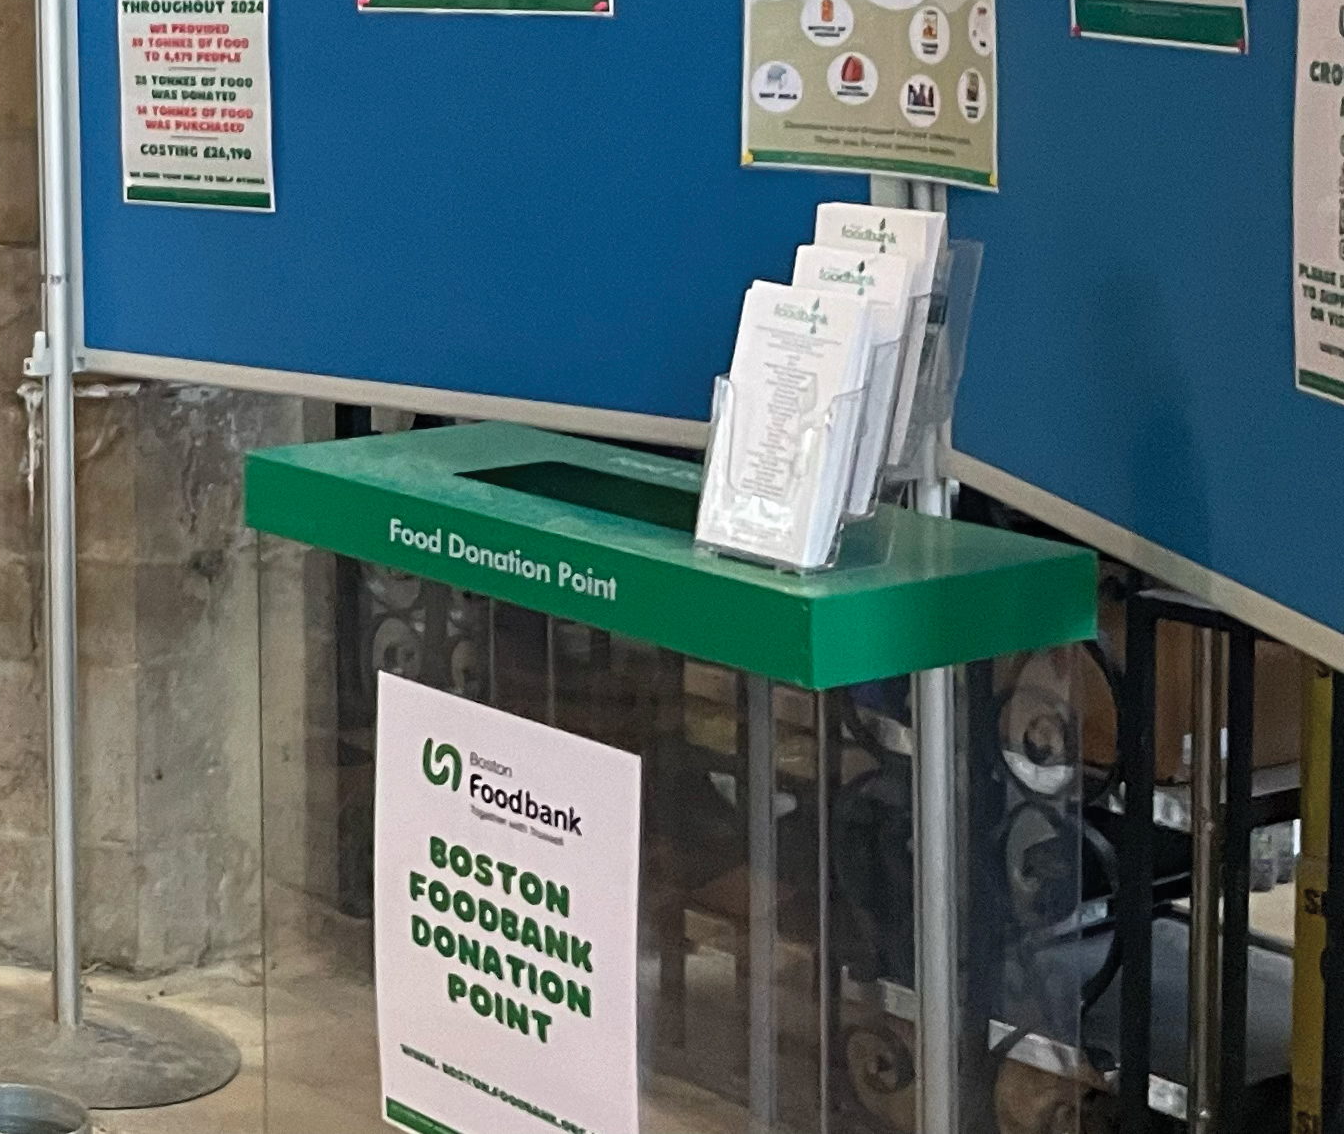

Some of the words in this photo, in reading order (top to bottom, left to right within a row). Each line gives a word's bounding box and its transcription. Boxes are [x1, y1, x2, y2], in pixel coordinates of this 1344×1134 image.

[122, 0, 225, 13] THROUGHOUT
[231, 0, 264, 13] 2024
[150, 24, 167, 33] WE
[172, 24, 229, 34] PROVIDED
[149, 38, 193, 48] TONNES
[198, 38, 213, 48] OF
[217, 38, 249, 48] FOOD
[145, 52, 159, 61] TO
[197, 52, 241, 63] PEOPLE
[152, 76, 196, 86] TONNES
[201, 77, 215, 86] OF
[221, 78, 253, 88] FOOD
[152, 90, 177, 99] WAS
[182, 90, 236, 102] DONATED
[152, 106, 197, 116] TONNES
[202, 108, 217, 117] OF
[221, 109, 253, 119] FOOD
[145, 120, 170, 130] WAS
[175, 120, 244, 132] PURCHASED
[141, 144, 197, 157] COSTING
[389, 518, 441, 554] Food
[448, 532, 551, 583] Donation
[558, 561, 617, 601] Point
[470, 751, 513, 778] Boston
[470, 773, 583, 837] Foodbank
[430, 836, 570, 918] BOSTON
[409, 870, 593, 973] FOODBANK
[411, 914, 592, 1018] DONATION
[447, 972, 552, 1044] POINT
